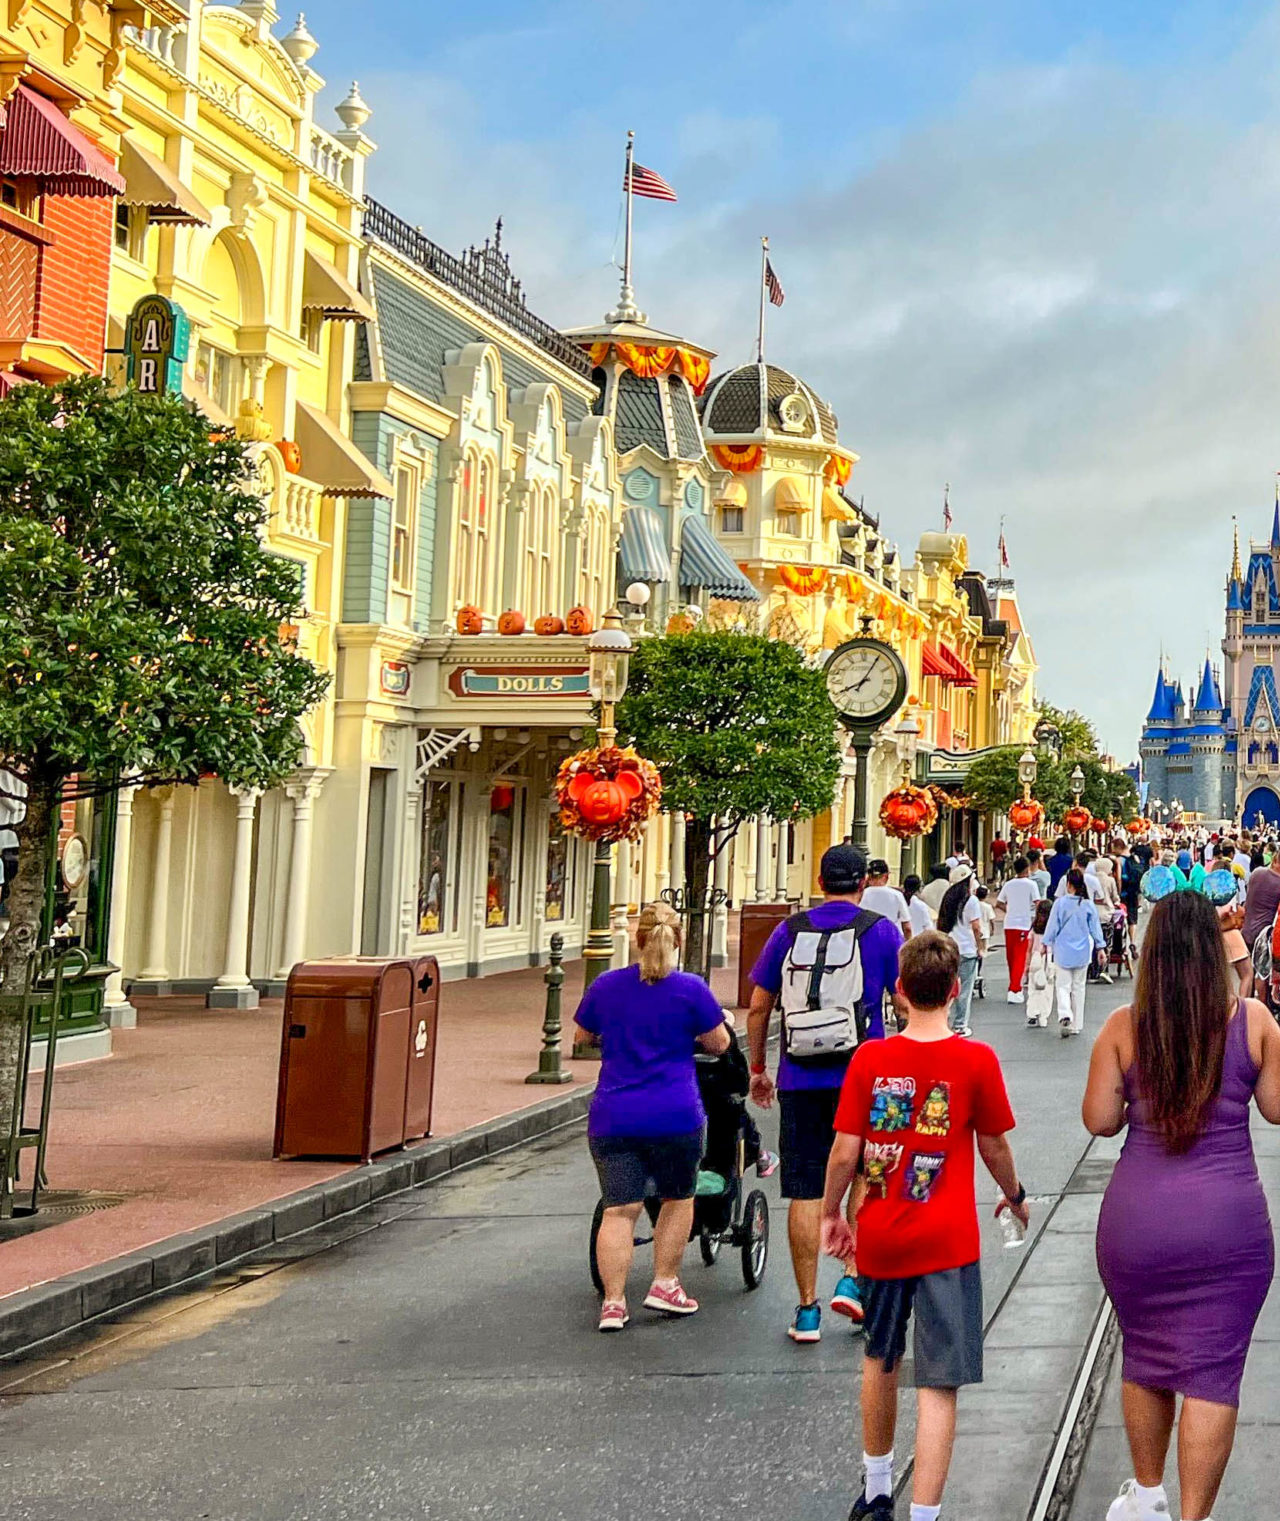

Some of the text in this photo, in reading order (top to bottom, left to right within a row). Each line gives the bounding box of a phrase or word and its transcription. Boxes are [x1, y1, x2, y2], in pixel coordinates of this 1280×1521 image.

[497, 677, 563, 692] DOLLS
[872, 1077, 916, 1097] LEO
[915, 1123, 947, 1136] RAPH
